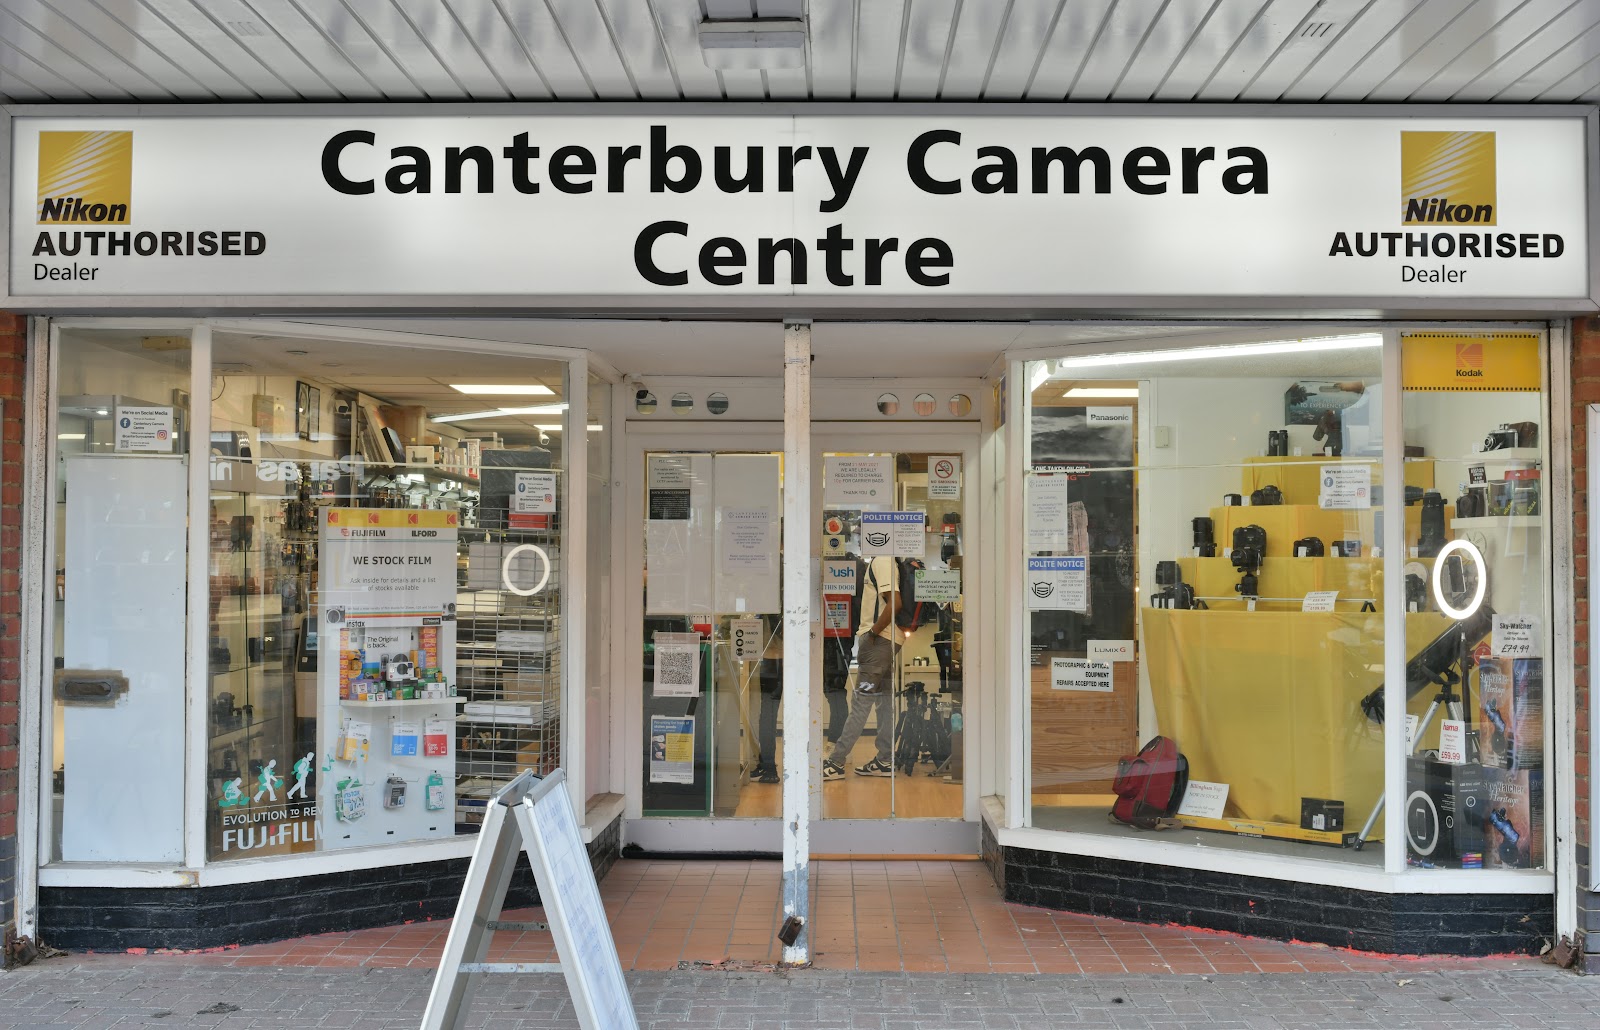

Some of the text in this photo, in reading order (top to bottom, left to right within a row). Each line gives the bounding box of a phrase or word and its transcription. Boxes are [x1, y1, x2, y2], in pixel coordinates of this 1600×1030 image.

[320, 125, 1269, 213] Canterbury Camera
[40, 198, 127, 222] Nikon
[1405, 198, 1492, 222] Nikon
[32, 231, 266, 256] AUTHORISED
[1328, 232, 1565, 258] AUTHORISED
[633, 220, 954, 287] Centre
[34, 264, 99, 281] Dealer
[1401, 265, 1467, 282] Dealer
[353, 556, 432, 565] WE STOCK FILM
[1501, 644, 1529, 653] £79.99
[1443, 722, 1458, 731] hama
[1441, 751, 1460, 760] £59.99
[1490, 792, 1519, 807] Heritage
[223, 810, 287, 826] EVOLUTION
